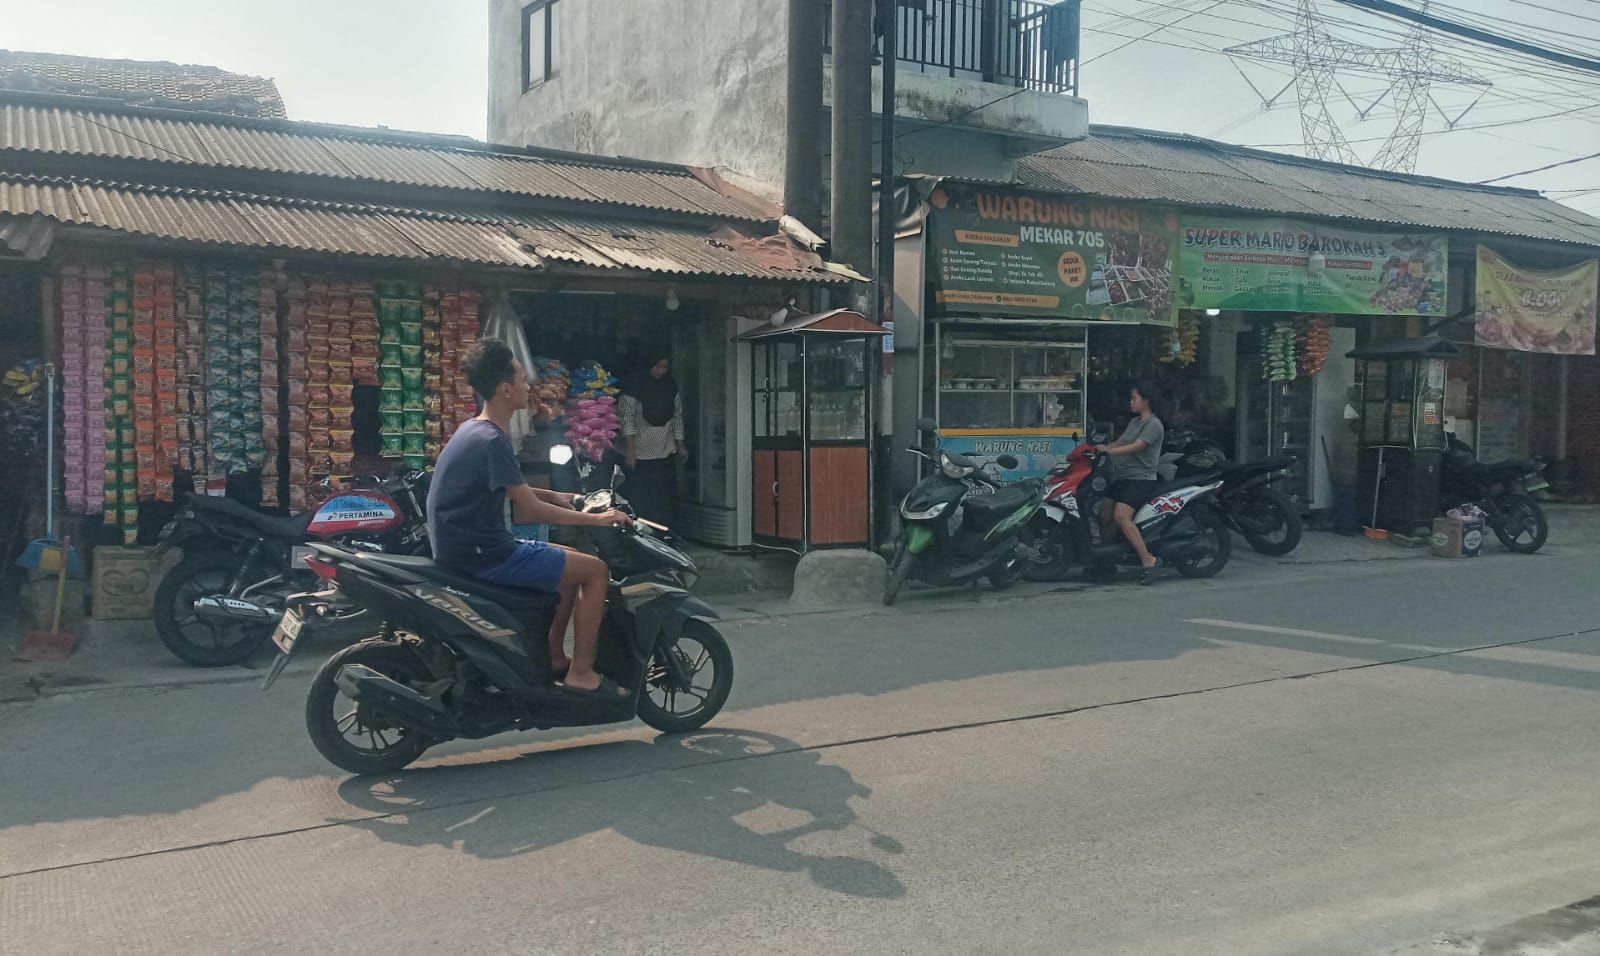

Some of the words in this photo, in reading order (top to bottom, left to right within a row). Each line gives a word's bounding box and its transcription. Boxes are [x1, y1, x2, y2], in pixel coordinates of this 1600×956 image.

[978, 193, 1083, 226] WARUNG
[1090, 204, 1139, 232] NASI
[1020, 226, 1074, 246] MEKAR
[1076, 231, 1105, 248] 705
[1184, 227, 1245, 250] SUPER
[1246, 230, 1297, 252] MARIO
[975, 441, 1023, 453] WARUNG
[1026, 442, 1051, 453] NASI
[338, 510, 385, 520] PERTAMINA
